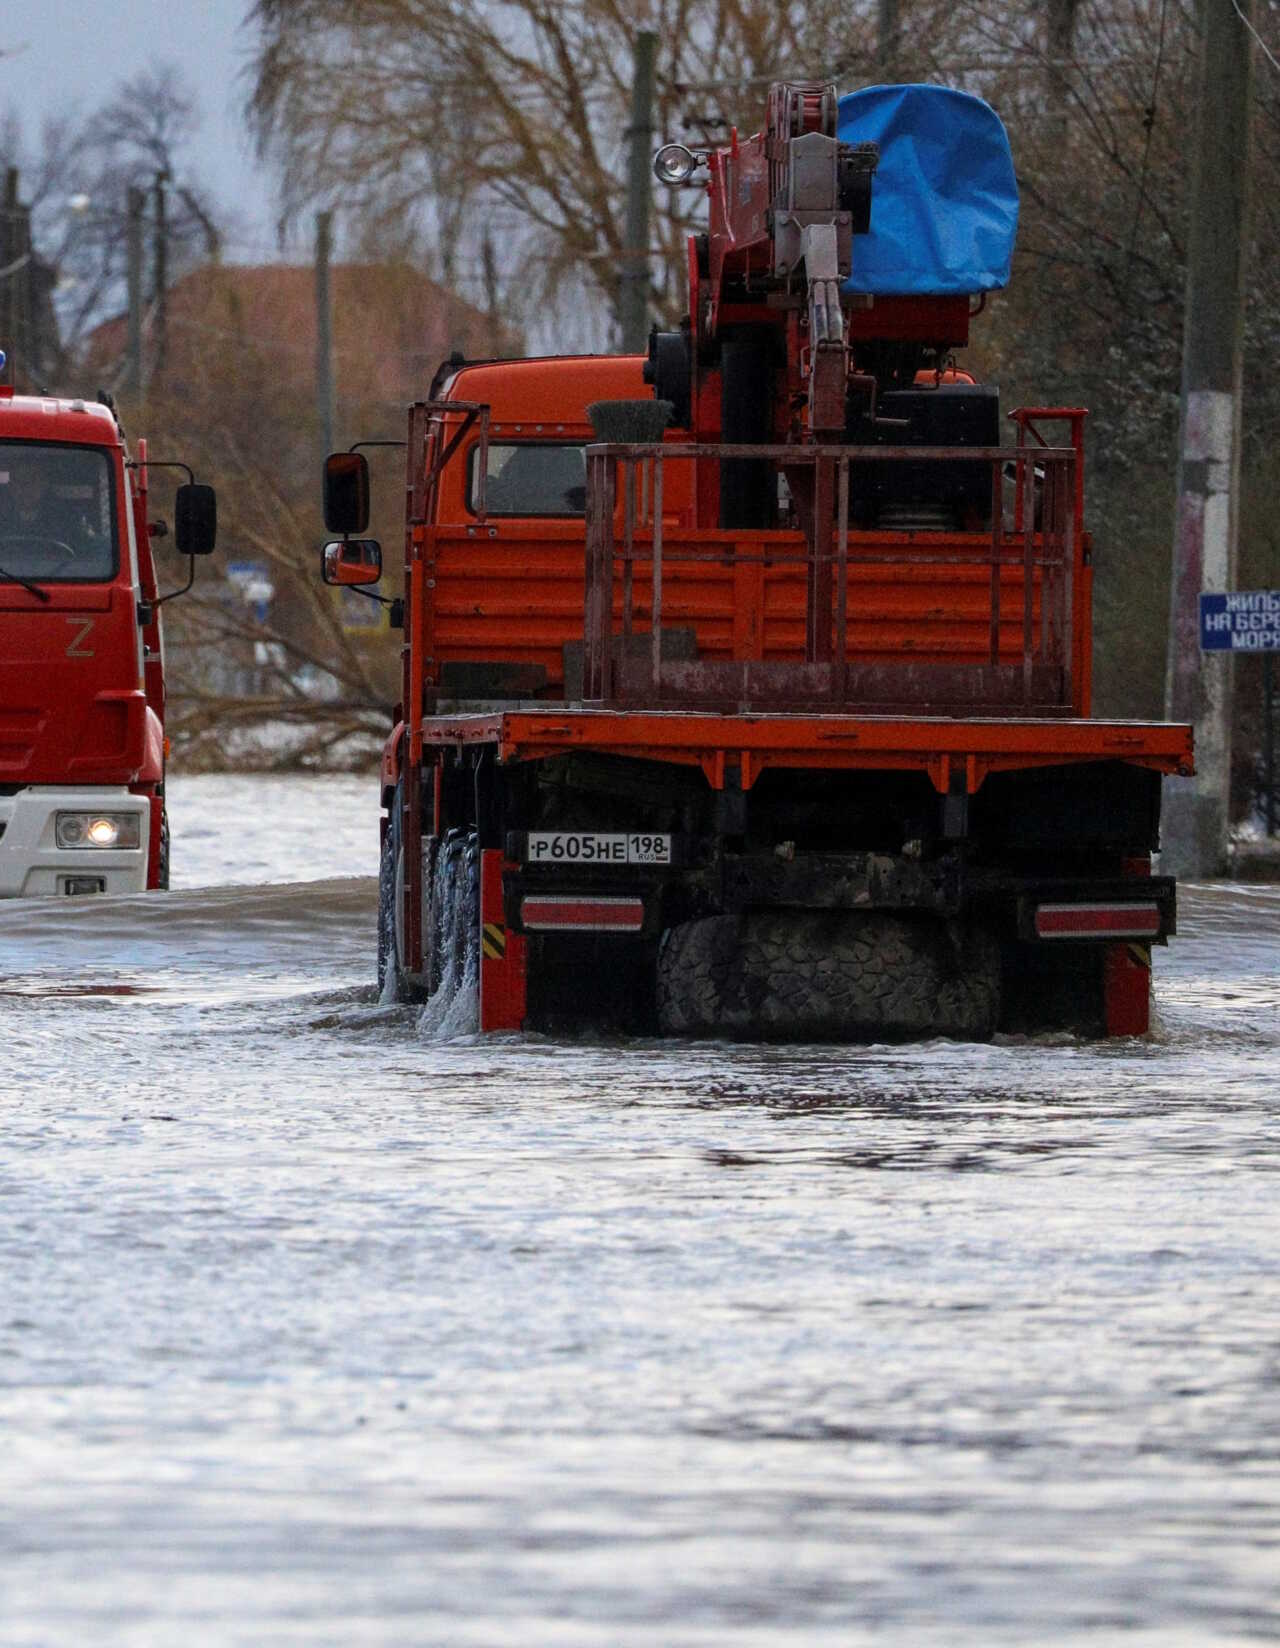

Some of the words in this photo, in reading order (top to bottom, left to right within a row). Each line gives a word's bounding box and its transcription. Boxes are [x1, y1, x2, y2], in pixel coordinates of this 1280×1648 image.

[1205, 612, 1232, 632] НА
[65, 617, 94, 656] Z
[631, 836, 664, 854] 198
